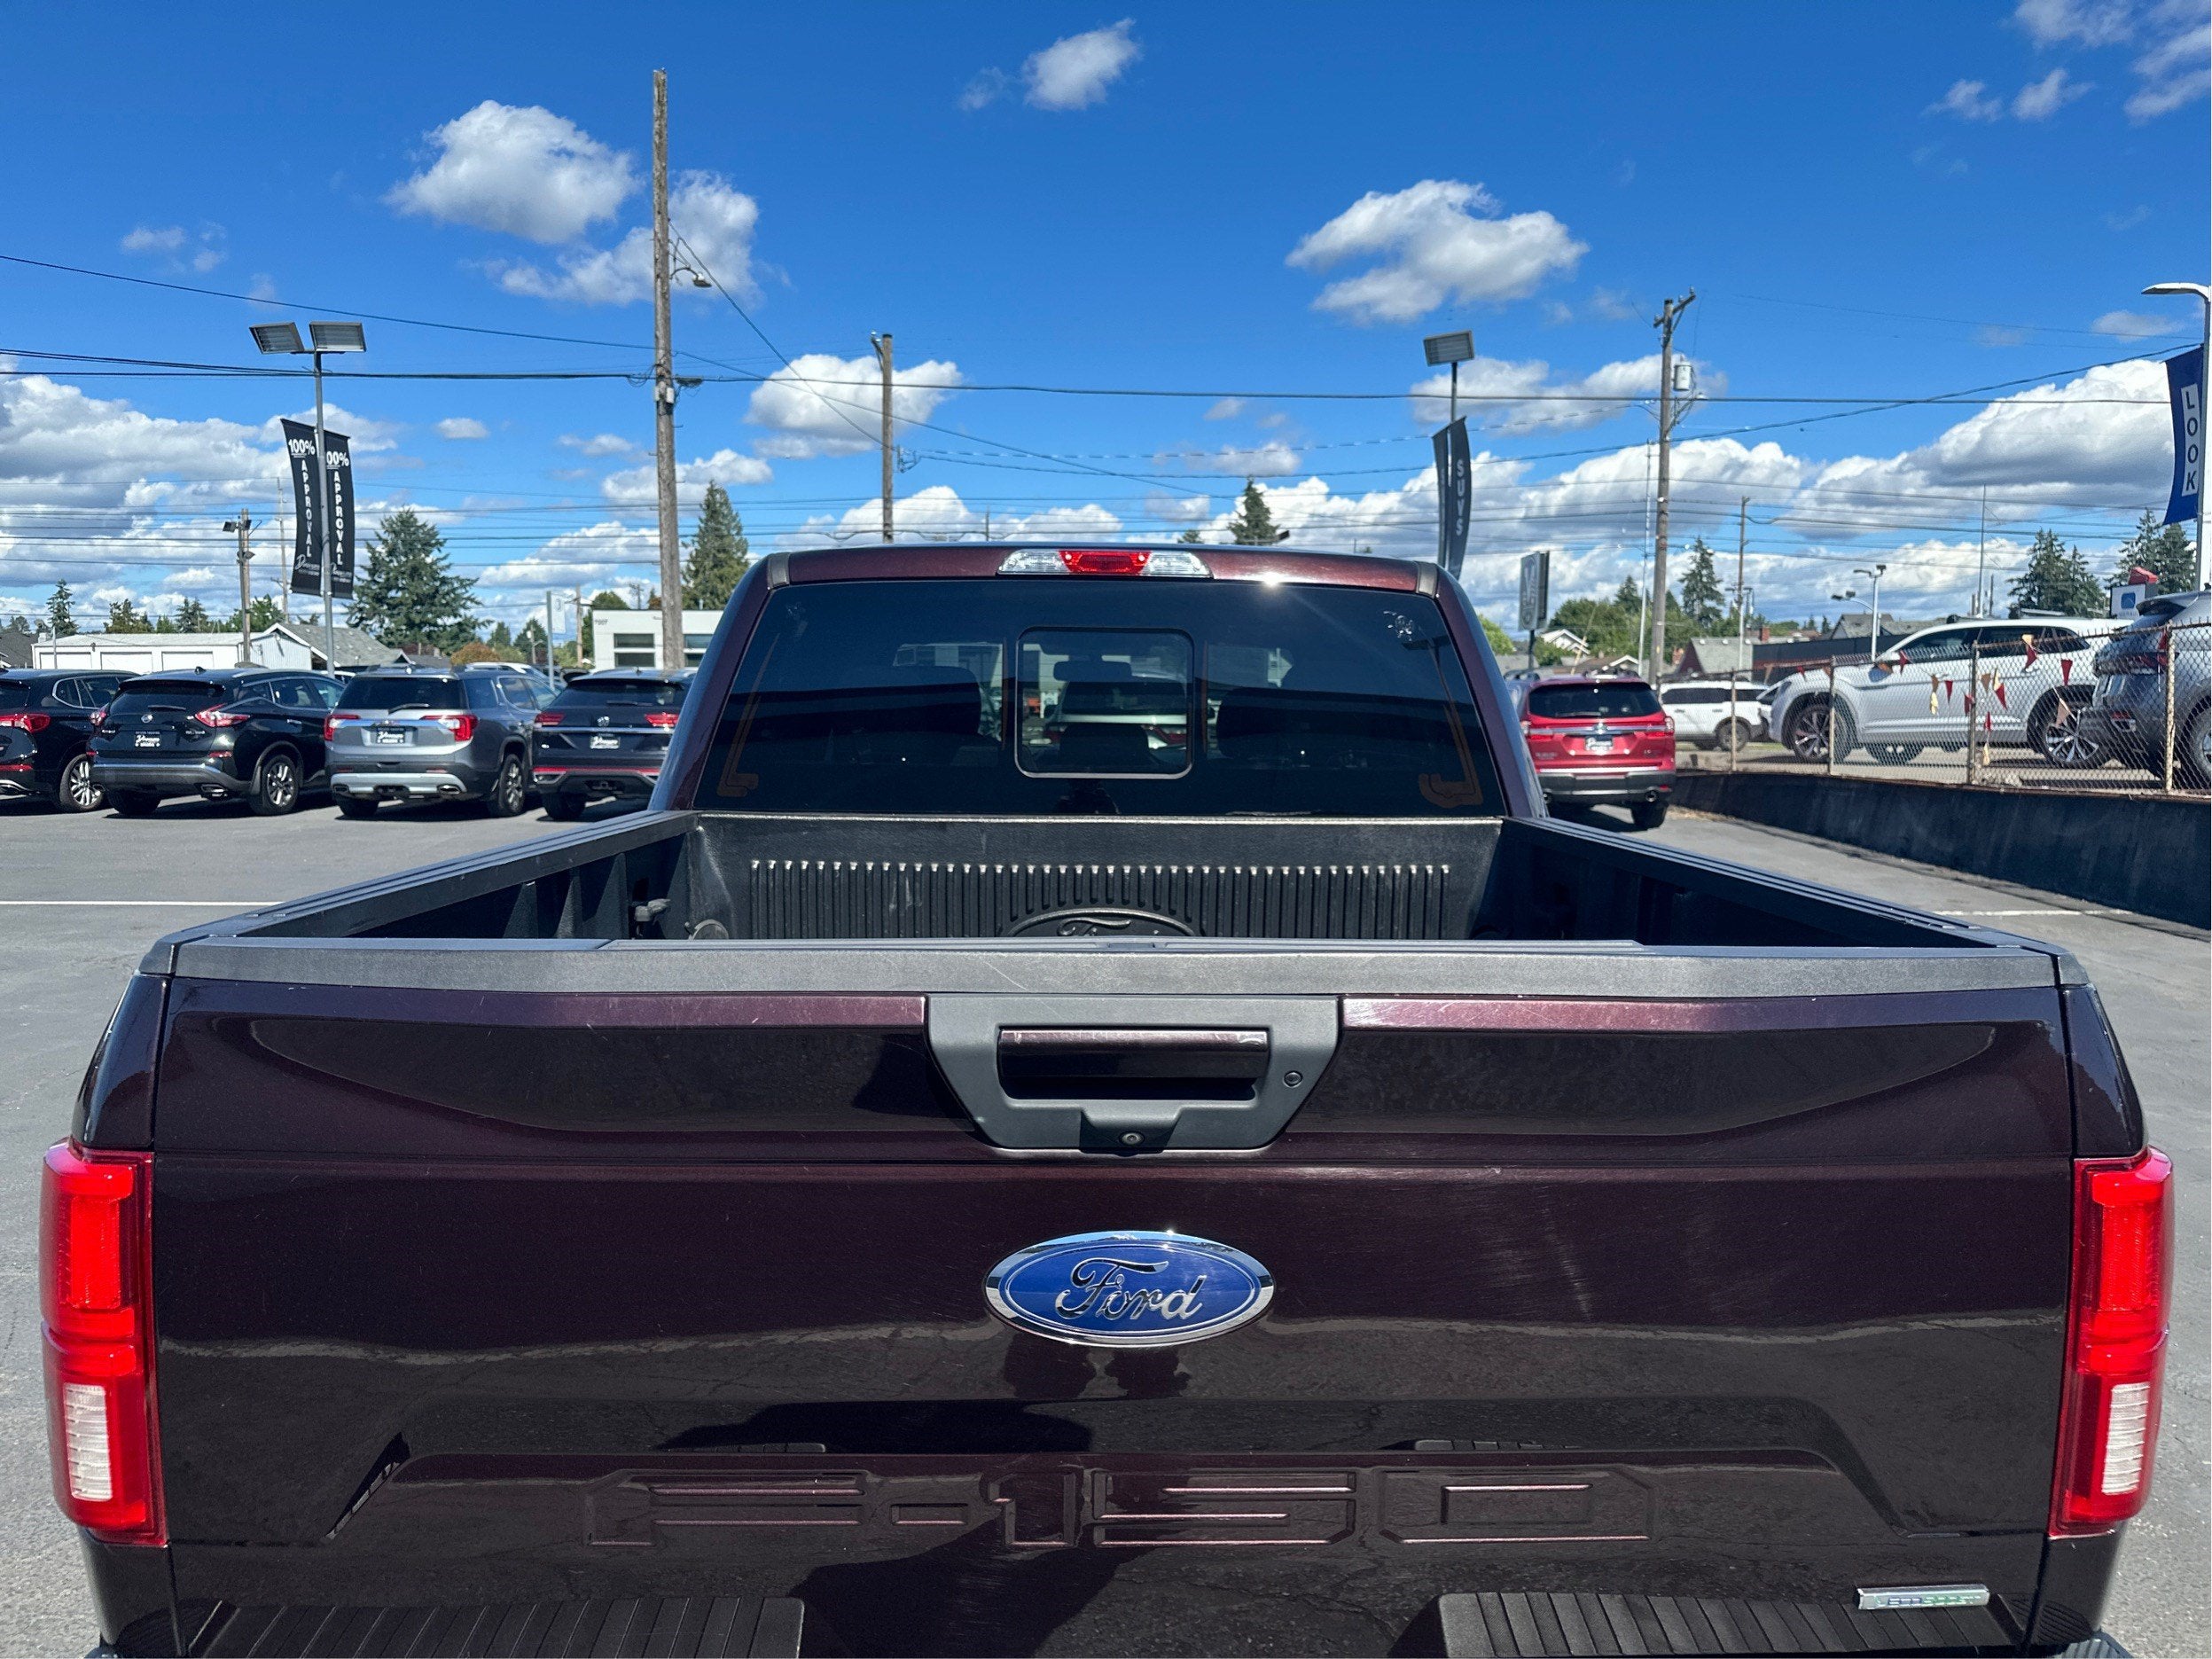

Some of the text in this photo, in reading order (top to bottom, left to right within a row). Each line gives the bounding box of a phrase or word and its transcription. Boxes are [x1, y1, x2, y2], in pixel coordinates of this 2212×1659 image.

[288, 439, 316, 456] 100%
[325, 450, 350, 467] 00%
[2185, 390, 2200, 492] LOOK
[301, 458, 313, 558] APPROVAL
[332, 470, 344, 566] APPROVAL
[1054, 1256, 1208, 1321] Ford
[588, 1467, 1655, 1547] F-150
